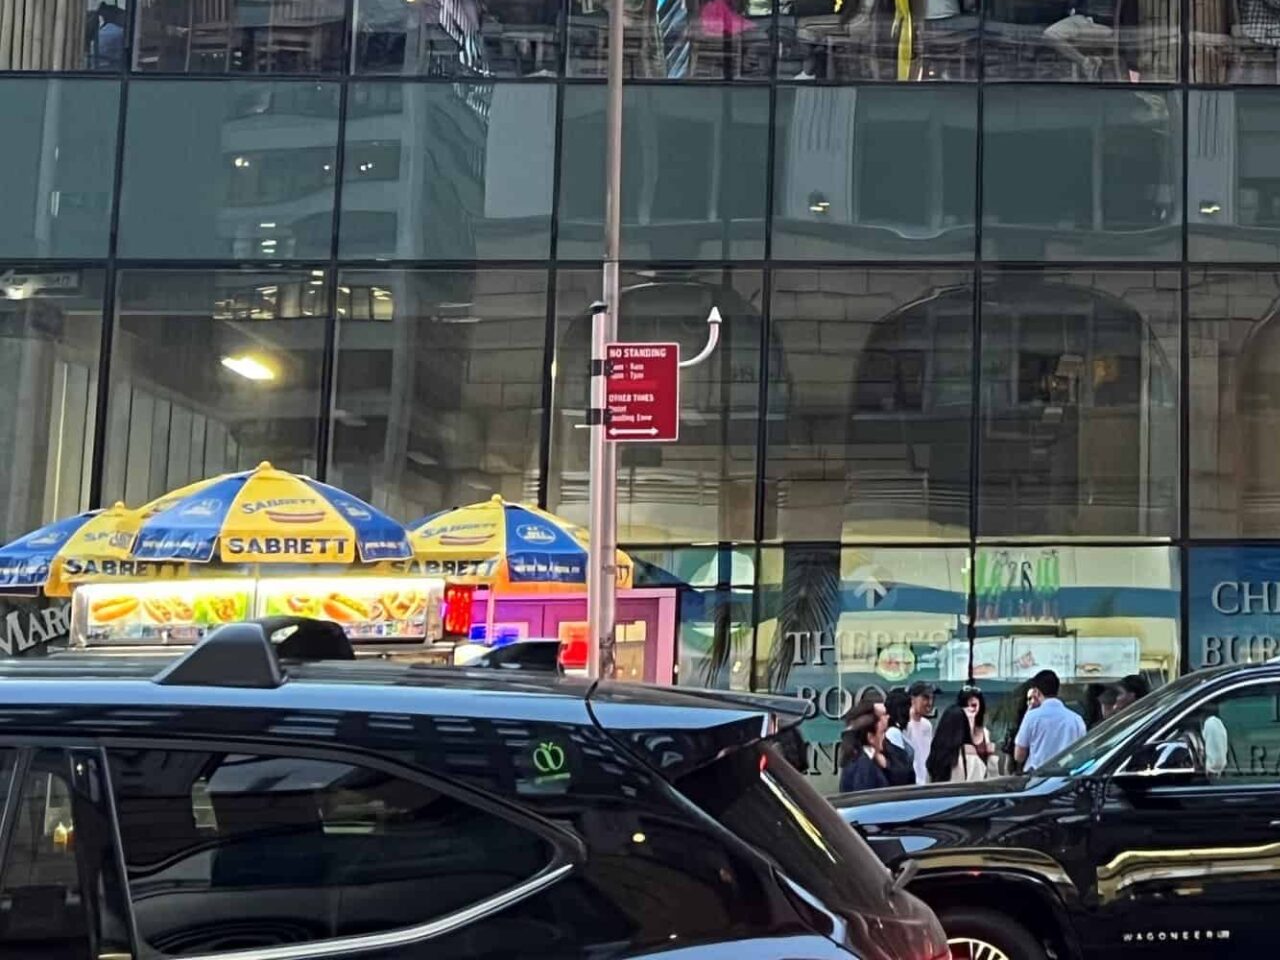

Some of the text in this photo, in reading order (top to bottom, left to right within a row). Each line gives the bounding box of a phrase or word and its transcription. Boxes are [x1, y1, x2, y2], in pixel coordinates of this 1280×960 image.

[609, 348, 667, 357] NO STANDING
[227, 537, 349, 555] SABRETT
[65, 558, 184, 576] SABRETT
[1122, 929, 1214, 942] WAGONEER
